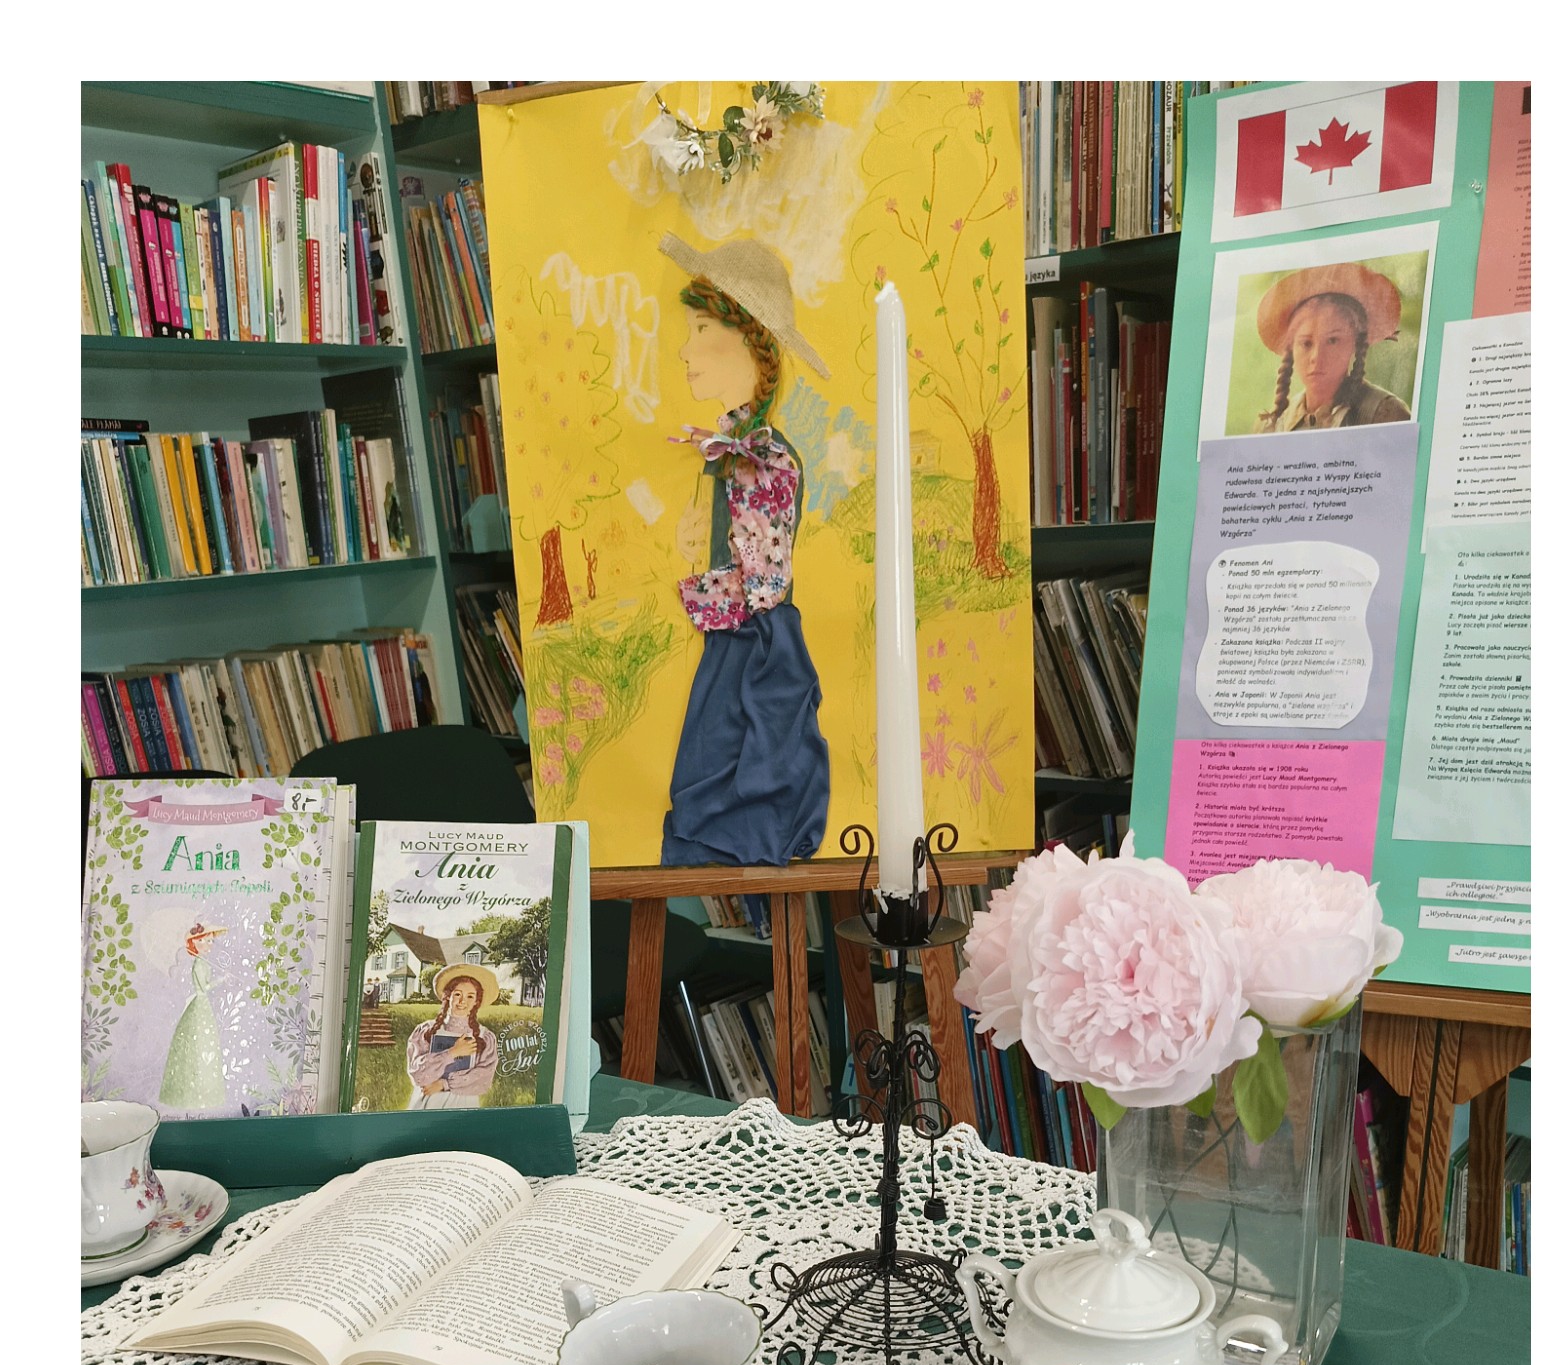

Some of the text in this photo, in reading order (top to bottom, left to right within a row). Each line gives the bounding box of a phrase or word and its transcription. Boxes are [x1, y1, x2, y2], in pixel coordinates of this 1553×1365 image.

[1030, 269, 1056, 282] języka
[174, 808, 201, 821] Maud
[161, 835, 241, 872] Ania
[400, 841, 528, 853] MONTGOMERY
[415, 851, 499, 879] Ania
[392, 889, 532, 911] Zielonego Wzgórza
[505, 1036, 525, 1052] 100
